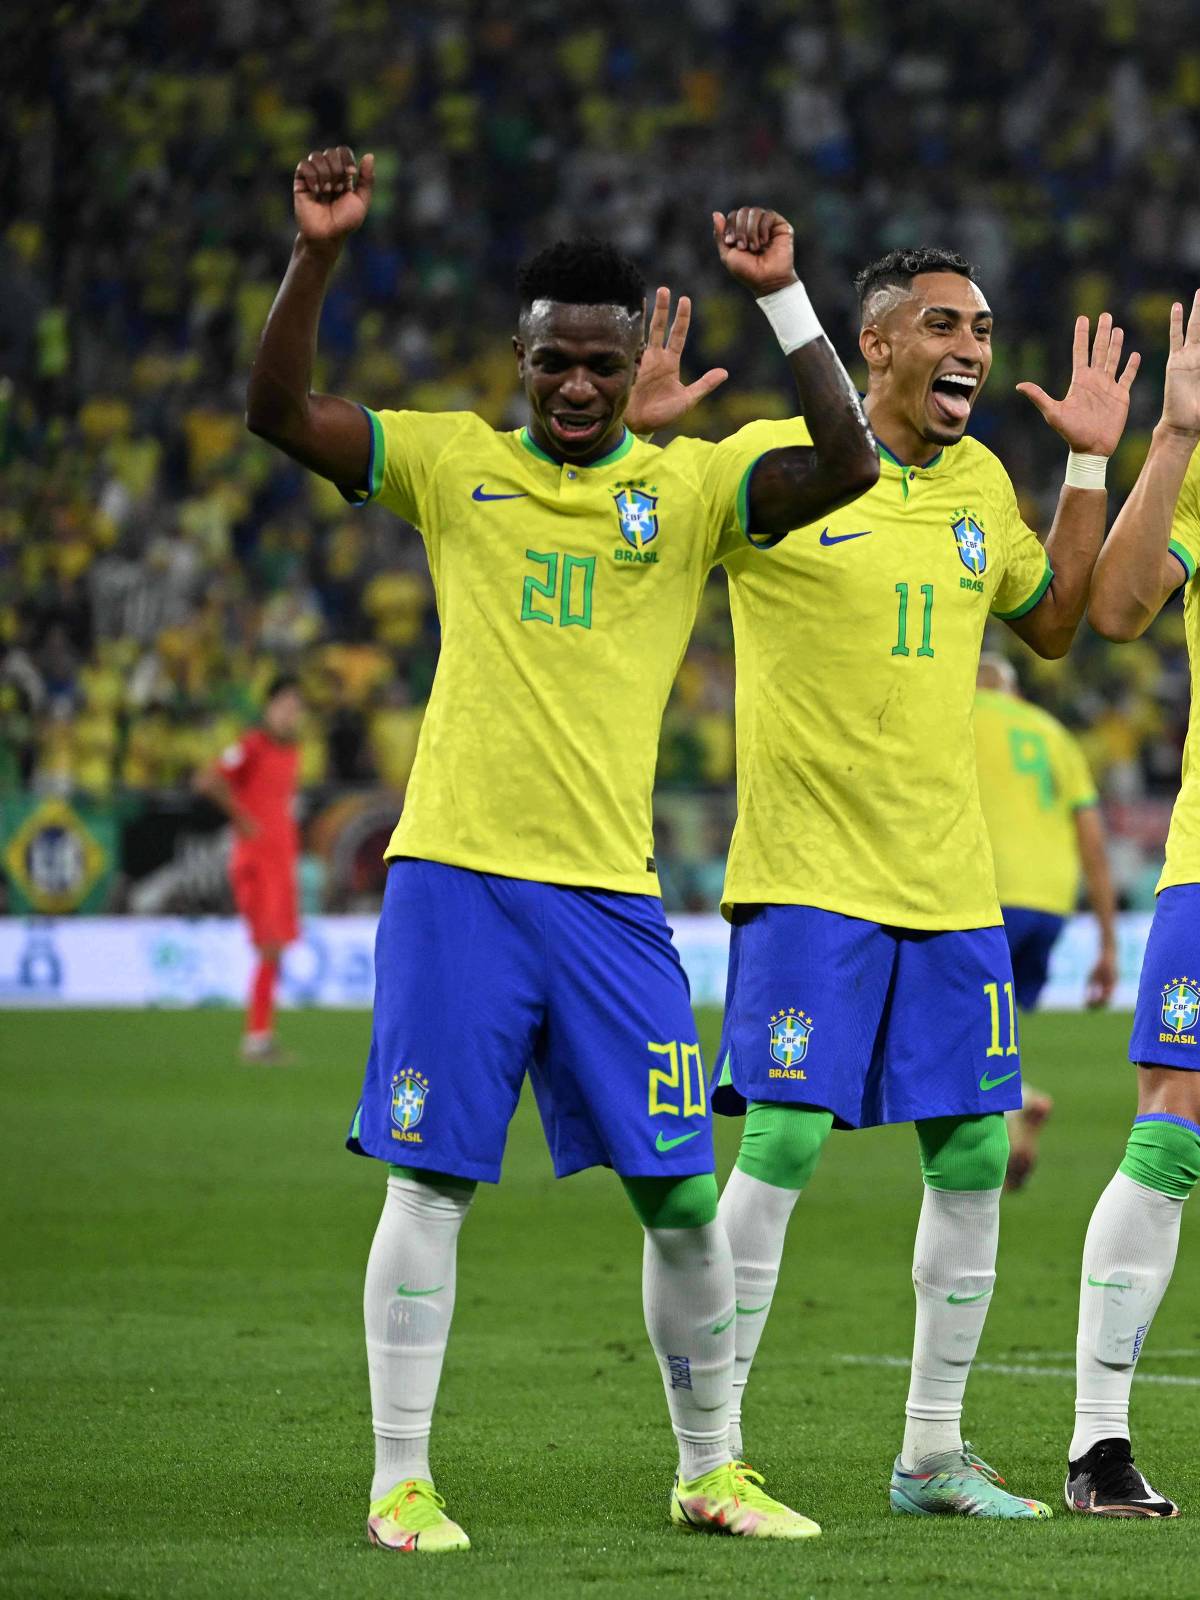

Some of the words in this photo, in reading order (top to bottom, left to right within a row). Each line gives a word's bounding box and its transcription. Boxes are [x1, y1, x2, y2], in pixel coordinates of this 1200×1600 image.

[965, 540, 978, 549] CBF
[614, 549, 659, 564] BRASIL
[520, 549, 596, 629] 20
[891, 582, 935, 658] 11
[1009, 726, 1055, 812] 9
[1173, 1003, 1189, 1011] CBF
[983, 982, 1019, 1057] 11
[781, 1036, 797, 1044] CBF
[1159, 1032, 1198, 1045] BRASIL
[648, 1040, 706, 1117] 20
[768, 1068, 807, 1080] BRASIL
[391, 1128, 423, 1143] BRASIL
[667, 1355, 692, 1391] BRASIL
